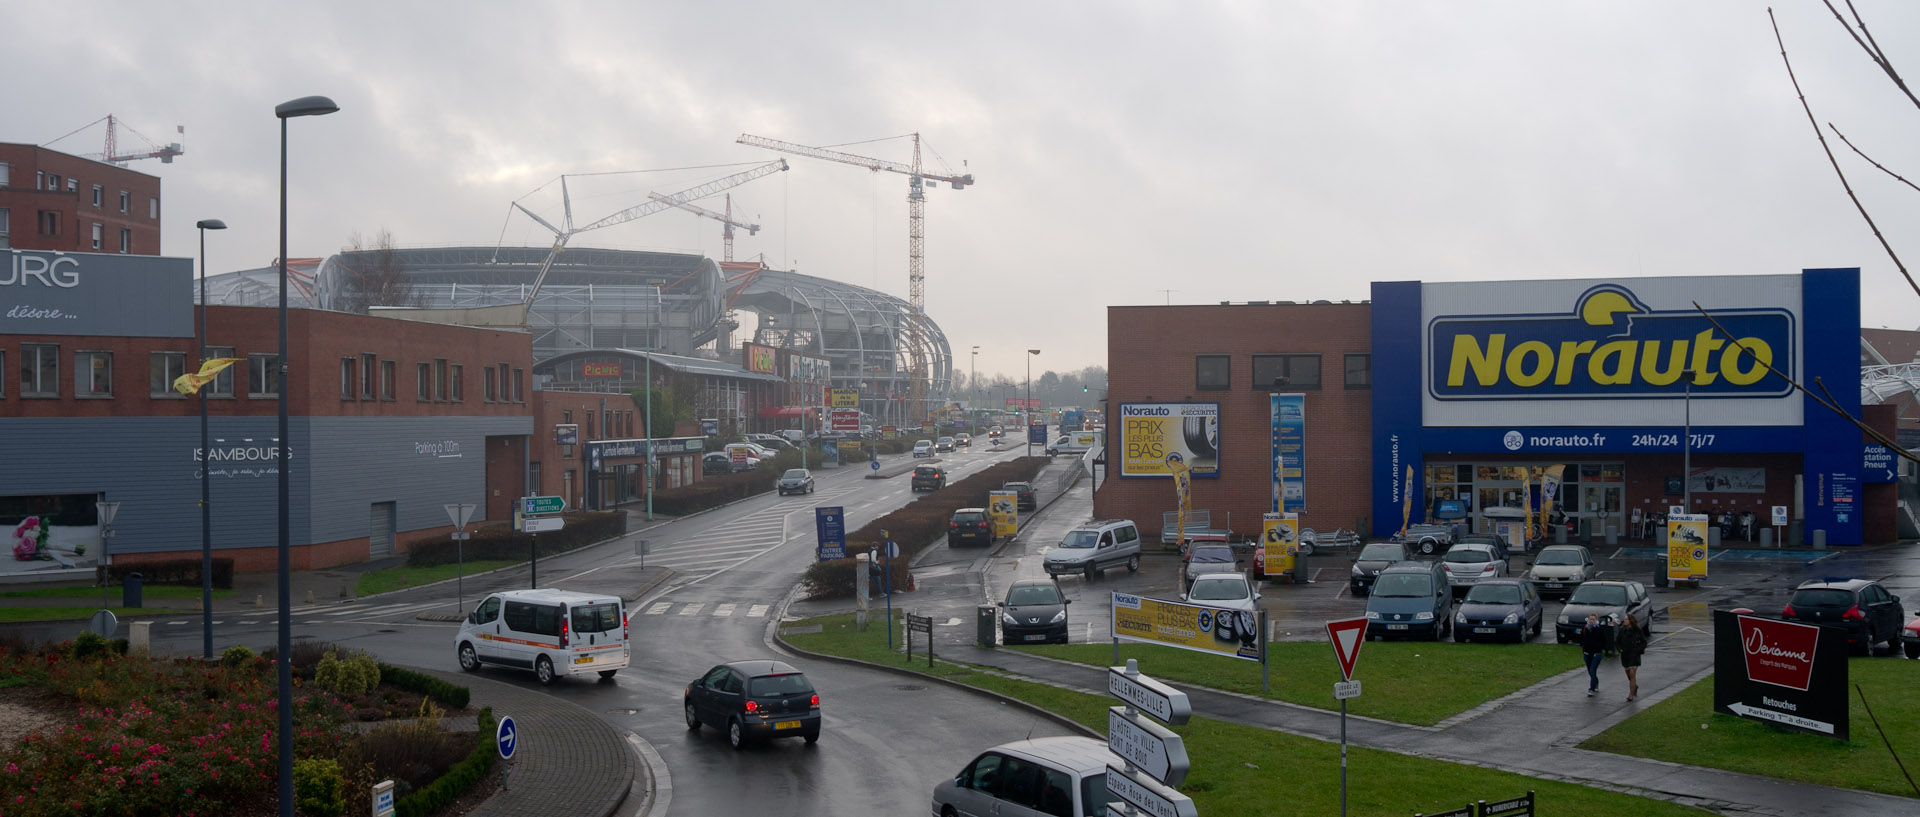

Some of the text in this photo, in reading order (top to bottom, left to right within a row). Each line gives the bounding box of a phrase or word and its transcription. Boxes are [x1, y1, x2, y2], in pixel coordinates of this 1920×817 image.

[6, 305, 62, 319] décore
[1447, 328, 1773, 388] Norauto
[1124, 406, 1170, 416] Norauto
[1127, 420, 1164, 435] PRIX
[1128, 434, 1164, 443] LES PLUS
[1530, 433, 1606, 449] norauto.fr
[1632, 433, 1715, 449] 24h/24 7j/7
[415, 441, 437, 456] Parking
[443, 440, 460, 452] 100m
[1128, 442, 1164, 459] BAS
[1864, 453, 1892, 461] station
[1864, 461, 1887, 469] Pneus
[1390, 434, 1399, 503] www.norauto.fr
[1671, 559, 1690, 567] BAS
[1115, 593, 1139, 604] Norauto
[1157, 623, 1174, 635] toute
[1158, 613, 1196, 629] PLUS BAS
[1746, 627, 1810, 662] Devianne
[1110, 678, 1163, 714] HELLEMMES-LILLE
[1763, 696, 1797, 711] Retouches
[1748, 707, 1775, 719] Parking
[1117, 717, 1132, 740] HÔTEL
[1140, 735, 1155, 754] VILLE
[1110, 732, 1148, 766] PONT DE BOIS
[1108, 772, 1127, 794] Espace
[1128, 786, 1142, 805] Rose
[1144, 795, 1155, 810] des
